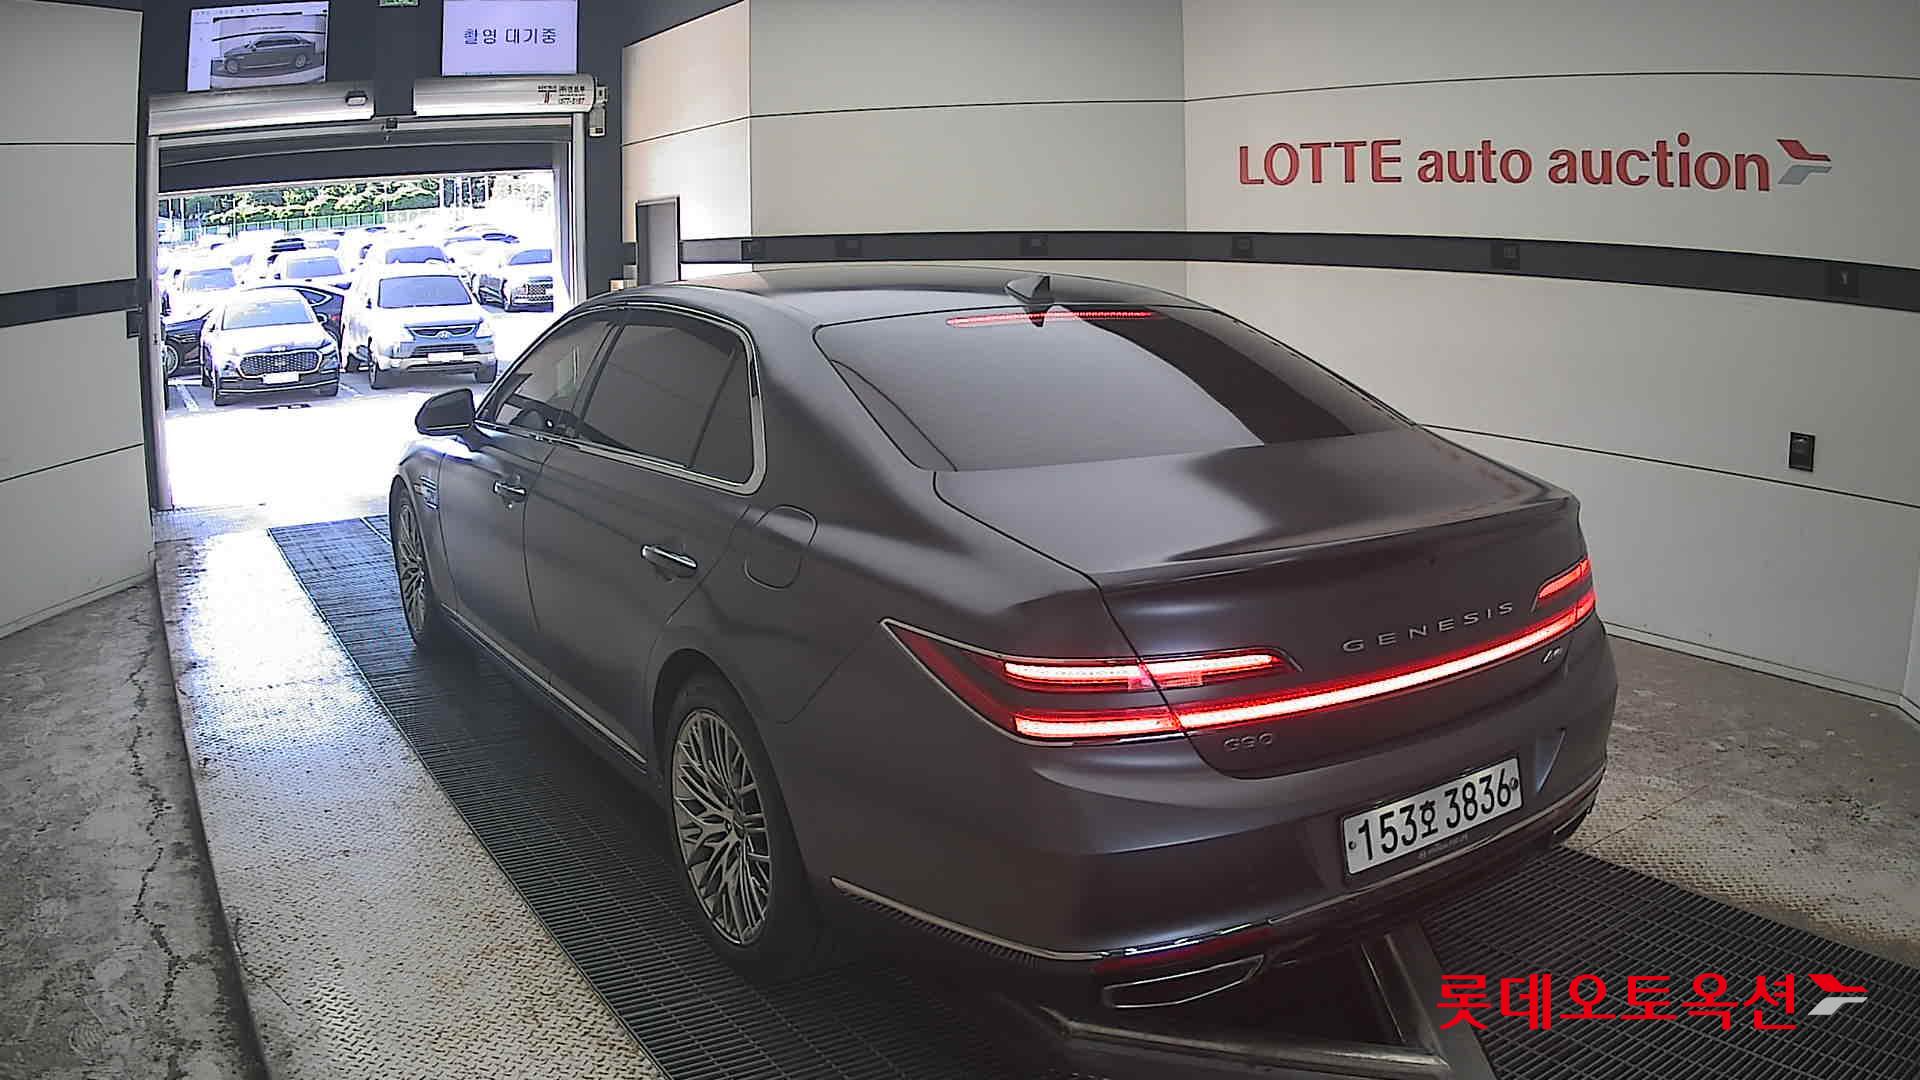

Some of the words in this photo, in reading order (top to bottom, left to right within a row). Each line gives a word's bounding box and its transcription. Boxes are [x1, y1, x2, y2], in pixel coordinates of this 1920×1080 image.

[505, 28, 557, 45] 대기중
[1239, 138, 1403, 186] LOTTE
[1416, 139, 1533, 185] auto
[1547, 132, 1771, 192] auction
[1342, 601, 1514, 652] GENESIS
[1444, 767, 1512, 829] 3836
